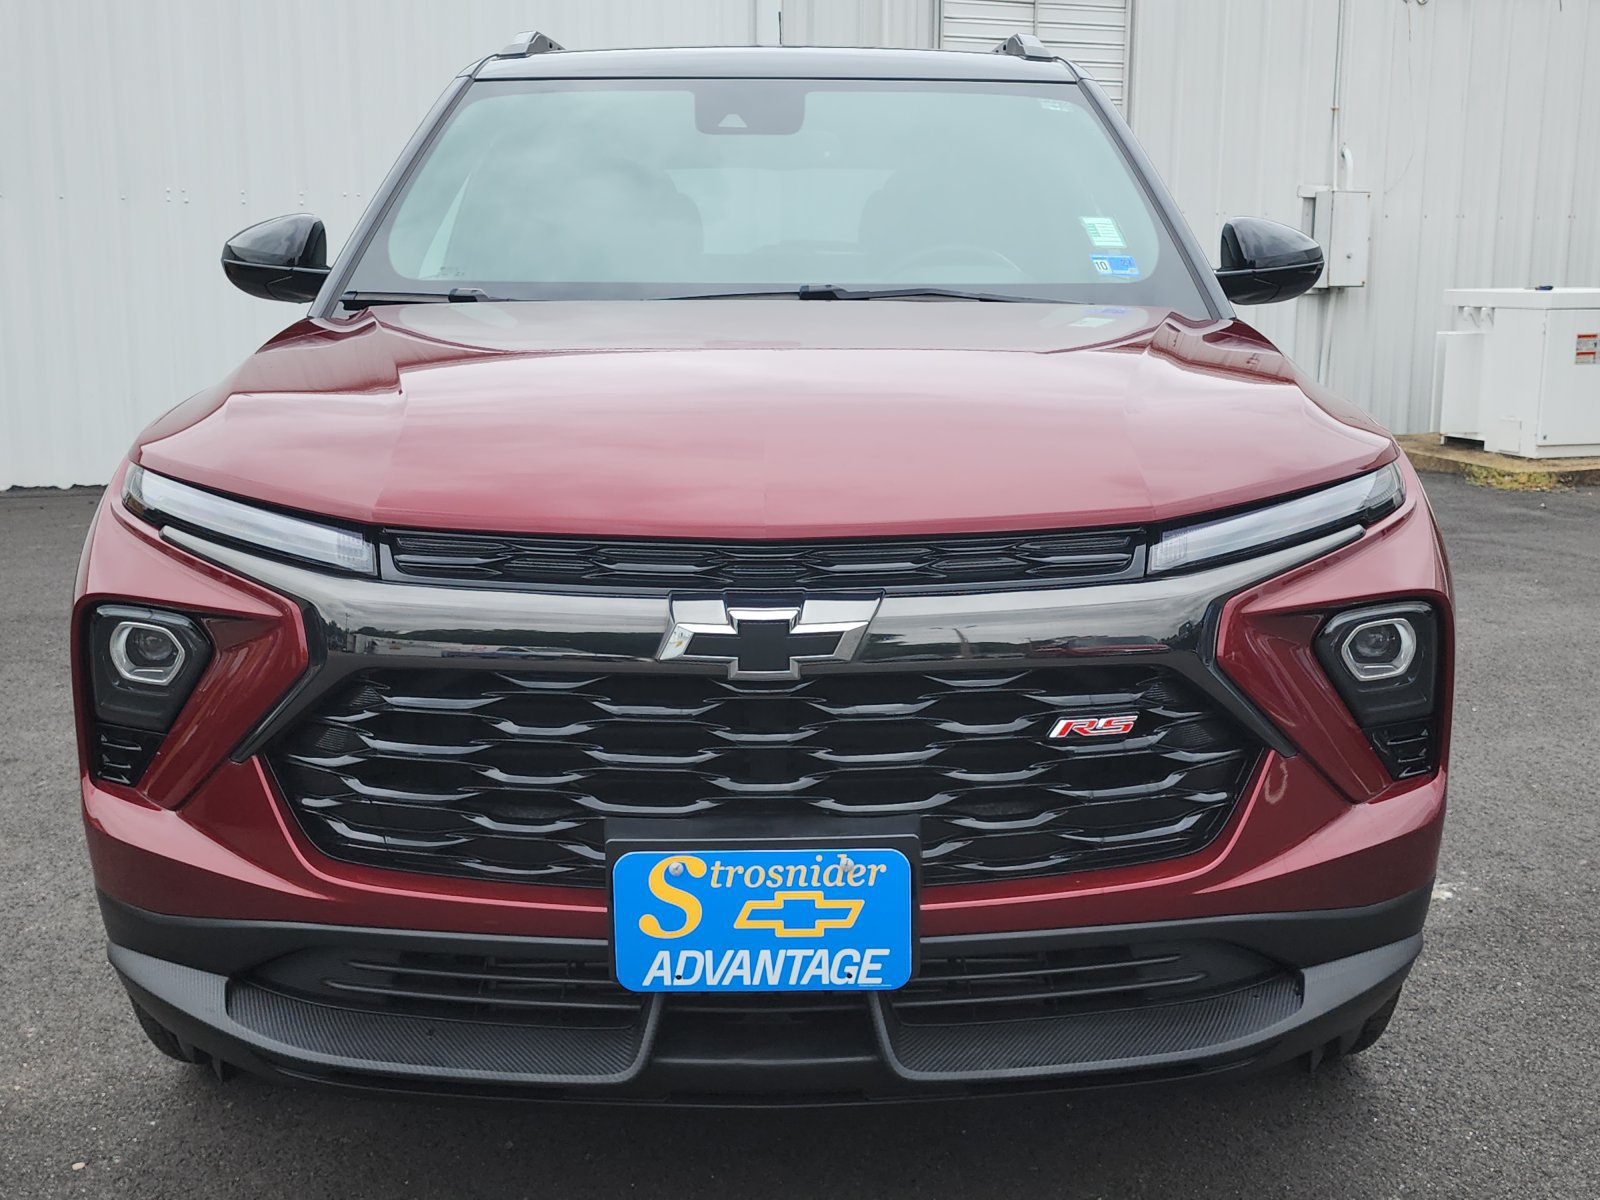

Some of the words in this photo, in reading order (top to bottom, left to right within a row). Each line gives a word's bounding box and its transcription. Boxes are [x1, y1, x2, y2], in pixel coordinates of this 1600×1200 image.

[1095, 261, 1109, 271] 10
[1049, 715, 1138, 738] RS
[638, 854, 887, 939] Strosnider
[642, 948, 890, 986] ADVANTAGE
